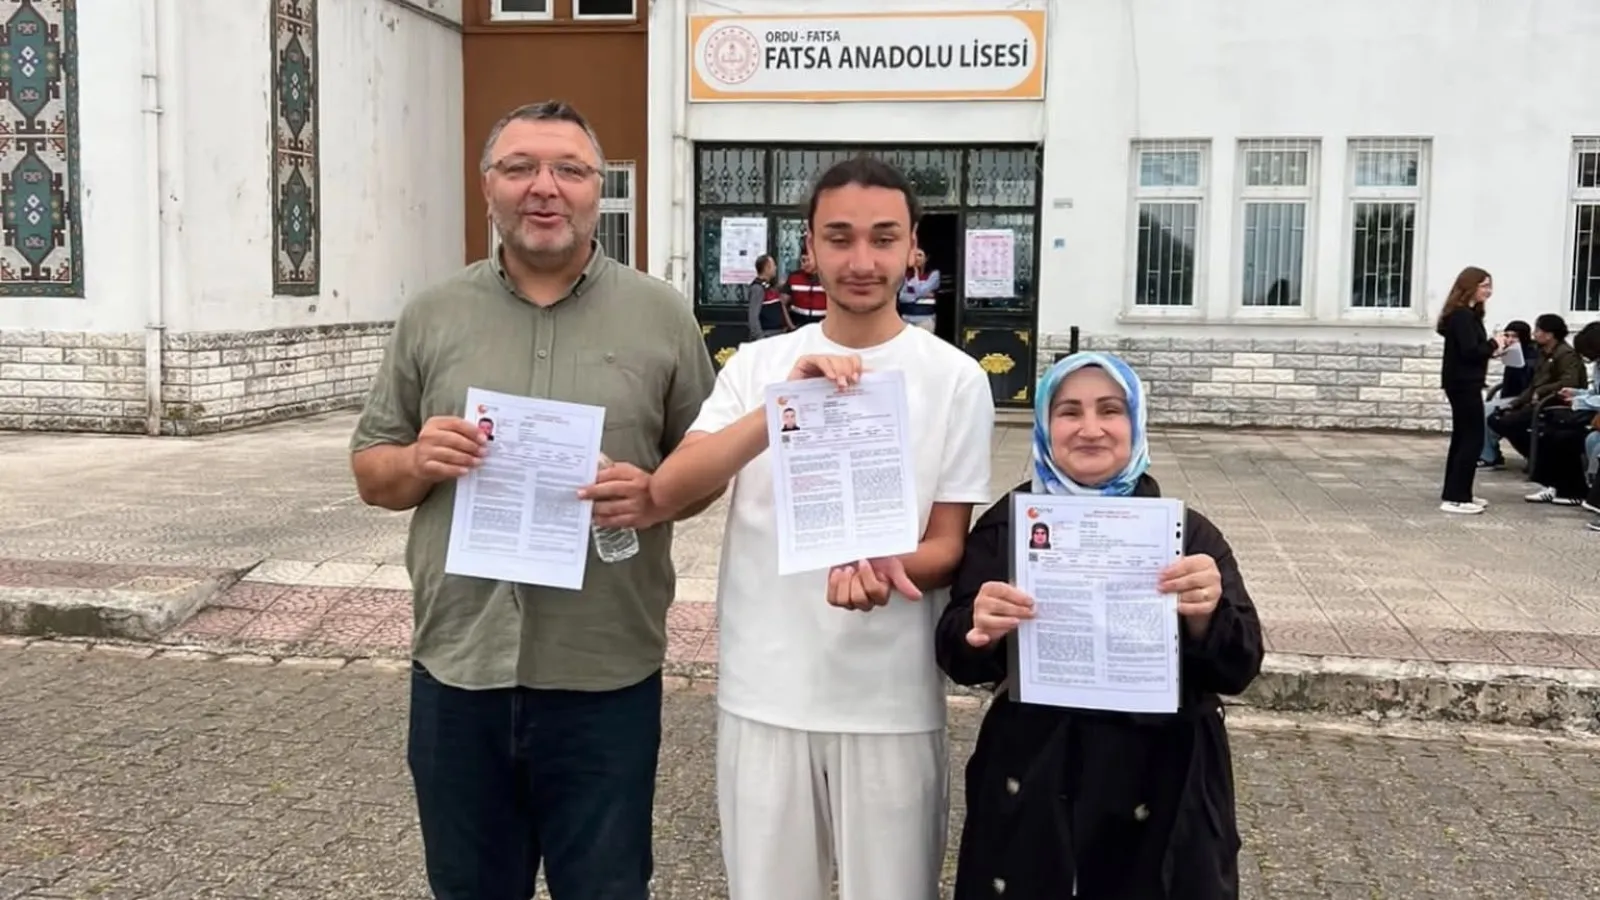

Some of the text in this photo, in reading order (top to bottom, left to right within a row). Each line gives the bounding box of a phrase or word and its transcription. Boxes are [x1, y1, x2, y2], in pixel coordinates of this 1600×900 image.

[765, 31, 798, 42] ORDU
[807, 30, 841, 42] FATSA
[765, 38, 1028, 69] FATSA ANADOLU LİSESİ
